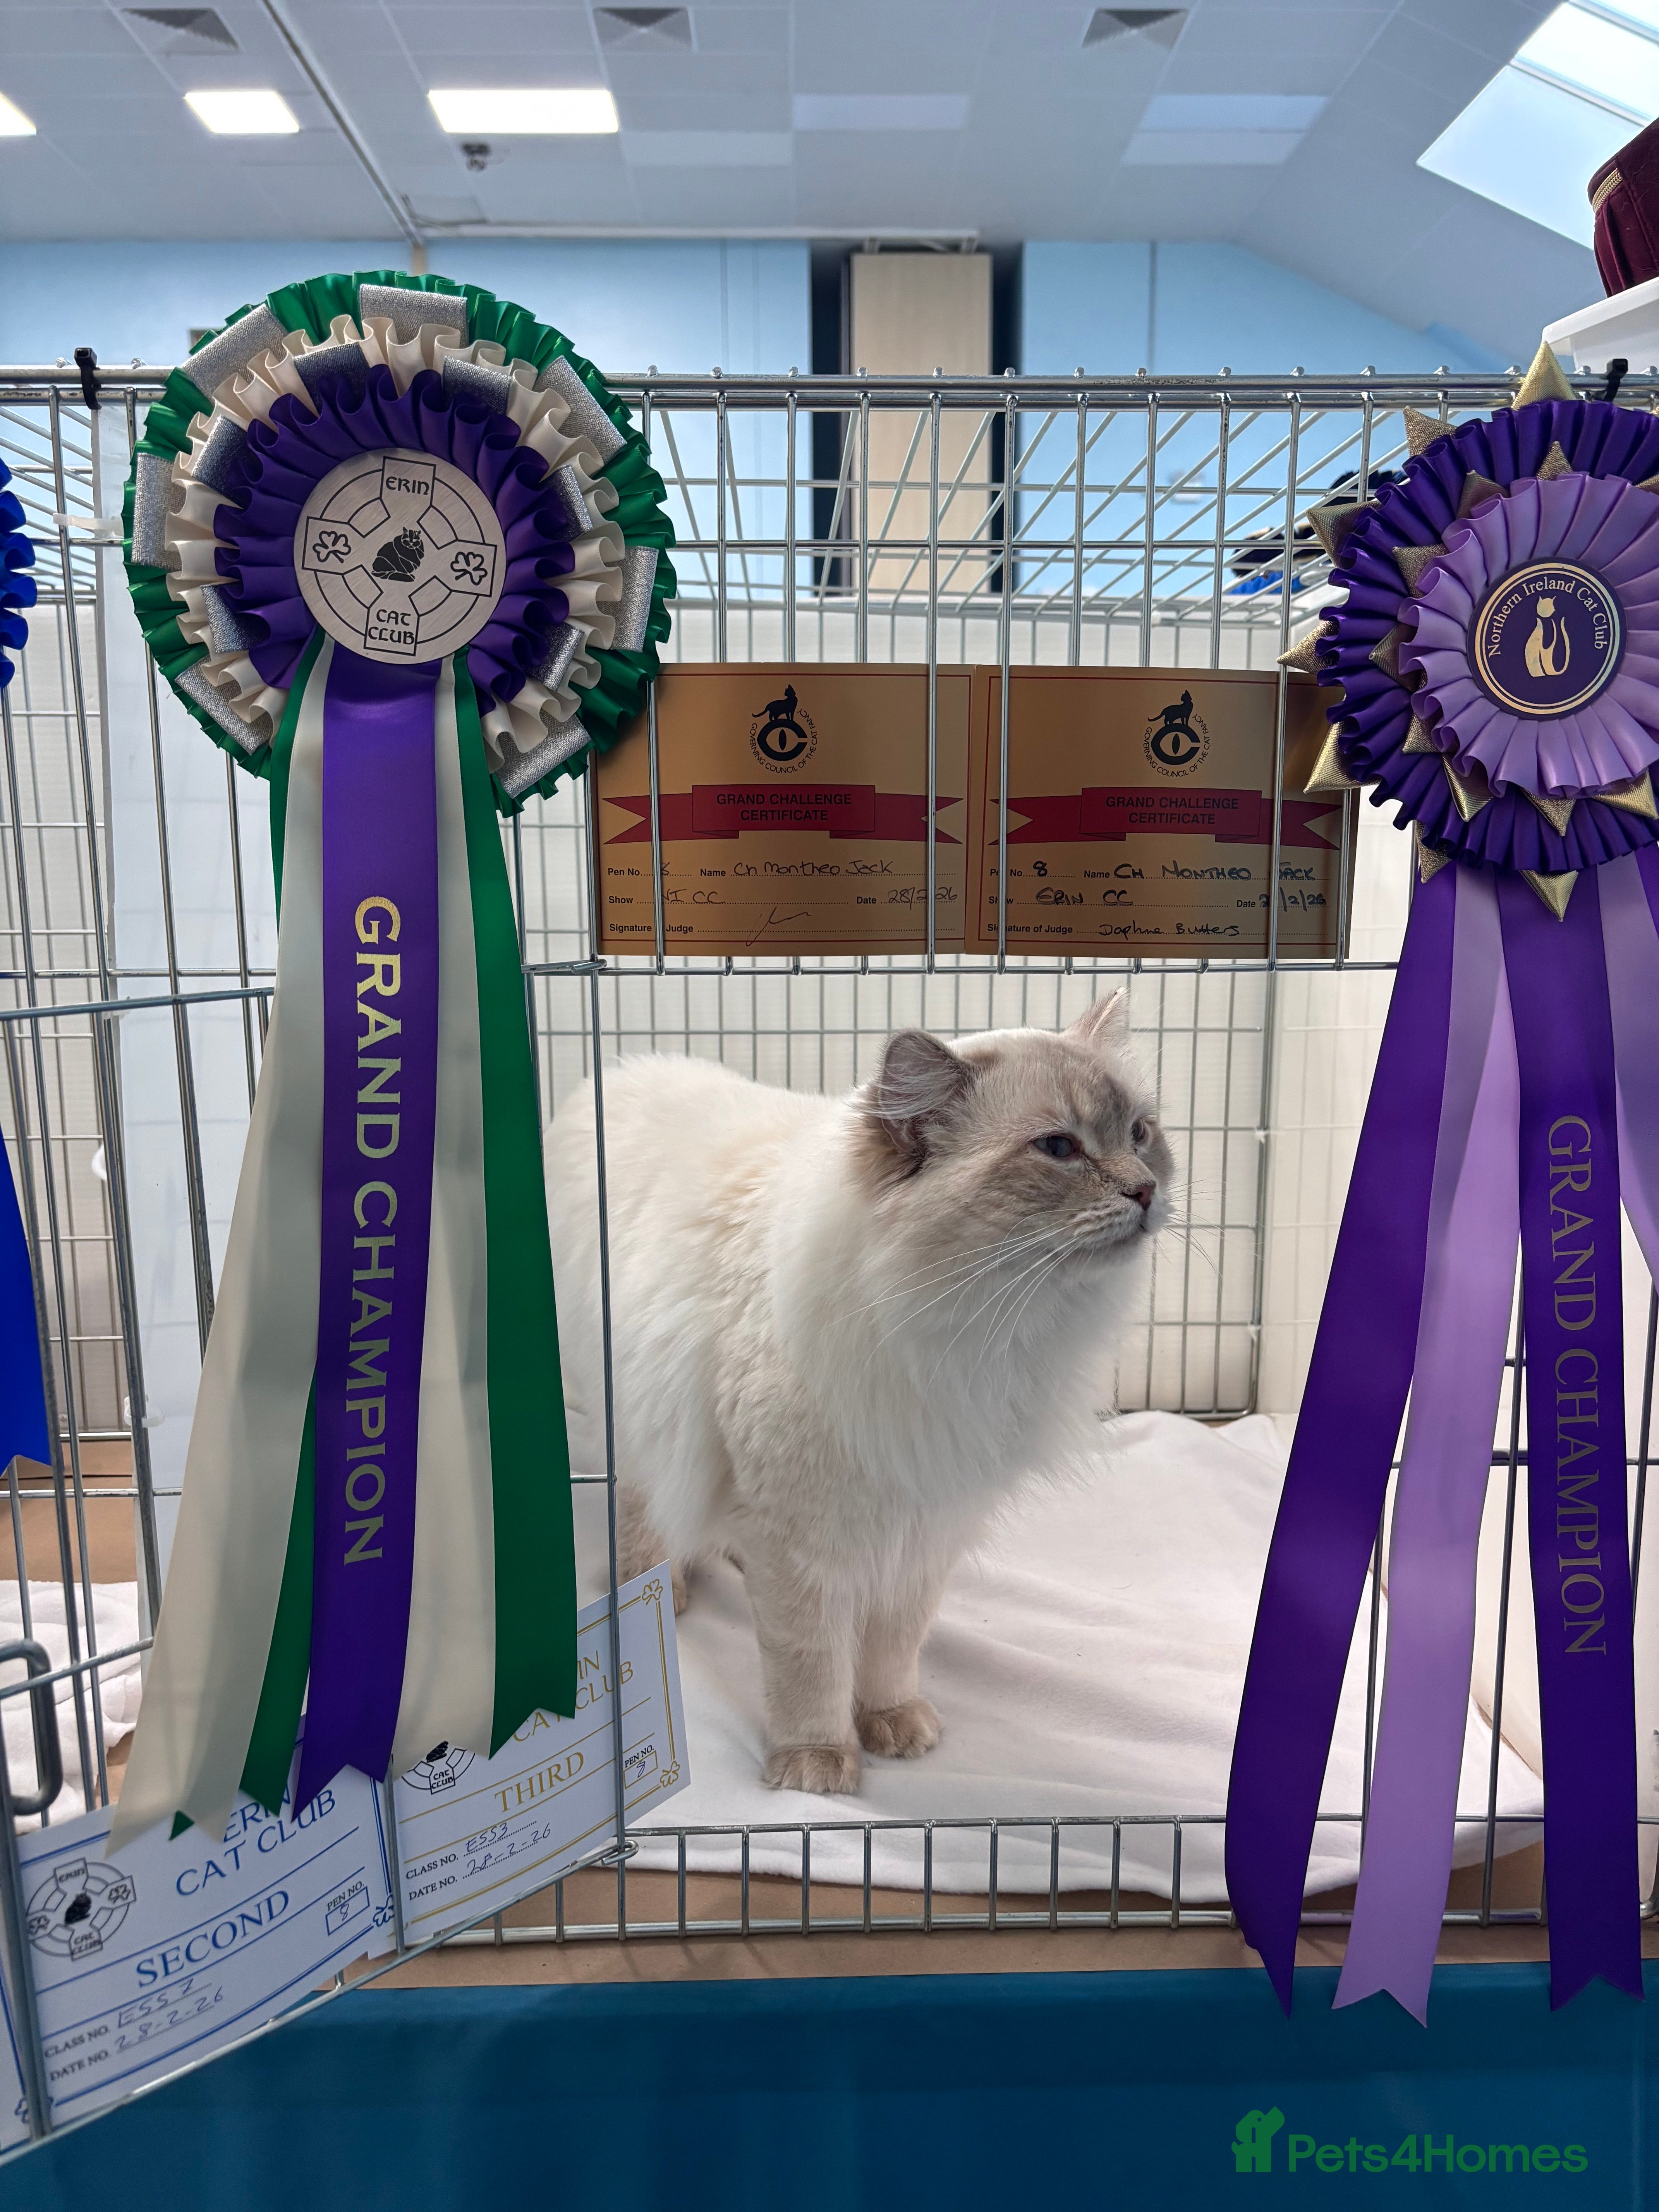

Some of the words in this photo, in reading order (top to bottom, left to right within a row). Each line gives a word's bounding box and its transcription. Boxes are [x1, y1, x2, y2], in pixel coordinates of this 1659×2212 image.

[385, 476, 431, 496] ERIN
[376, 609, 411, 627] CAT
[1487, 592, 1523, 658] Northern
[1522, 576, 1576, 597] Ireland
[1577, 587, 1598, 612] Cat
[1592, 612, 1608, 650] Club
[368, 626, 415, 645] CLUB
[797, 708, 816, 731] FANCY
[1192, 713, 1209, 734] FANCY
[749, 723, 766, 765] GOVERNING
[1143, 726, 1158, 769] GOVERNING
[805, 746, 816, 760] THE
[1196, 750, 1209, 764] THE
[765, 763, 798, 774] COUNCIL
[798, 759, 807, 768] OF
[1157, 766, 1190, 778] COUNCIL
[1189, 762, 1199, 773] OF
[716, 793, 766, 805] GRAND
[769, 793, 852, 805] CHALLENGE
[1105, 796, 1156, 808] GRAND
[1158, 797, 1239, 810] CHALLENGE
[740, 809, 828, 821] CERTIFICATE
[1128, 812, 1216, 825] CERTIFICATE
[608, 868, 625, 876] Pen
[700, 868, 726, 877] Name
[845, 859, 893, 876] Jack
[1032, 860, 1048, 877] 8
[1084, 870, 1110, 878] Name
[608, 896, 633, 904] Show
[692, 891, 726, 905] CC
[856, 896, 877, 904] Date
[1036, 887, 1084, 905] ERIN
[1103, 889, 1133, 906] CC
[1237, 900, 1256, 908] Date
[609, 924, 652, 934] Signature
[666, 924, 694, 934] Judge
[1033, 924, 1042, 933] of
[1045, 925, 1073, 934] Judge
[354, 895, 403, 1161] GRAND
[1548, 1115, 1598, 1331] GRAND
[343, 1179, 398, 1567] CHAMPION
[1554, 1348, 1607, 1656] CHAMPION
[625, 1752, 640, 1768] PEN
[641, 1745, 654, 1758] NO.
[431, 1776, 454, 1790] CLUB
[433, 1769, 450, 1781] CAT
[494, 1752, 584, 1813] THIRD
[176, 1839, 246, 1896] CAT
[405, 1861, 438, 1880] CLASS
[440, 1853, 459, 1867] NO.
[326, 1891, 346, 1911] PEN
[348, 1881, 364, 1897] NO.
[409, 1882, 437, 1901] DATE
[439, 1875, 458, 1887] NO.
[340, 1903, 349, 1921] 8
[136, 1888, 290, 1988] SECOND
[44, 2036, 85, 2058] CLASS
[49, 2057, 85, 2081] DATE
